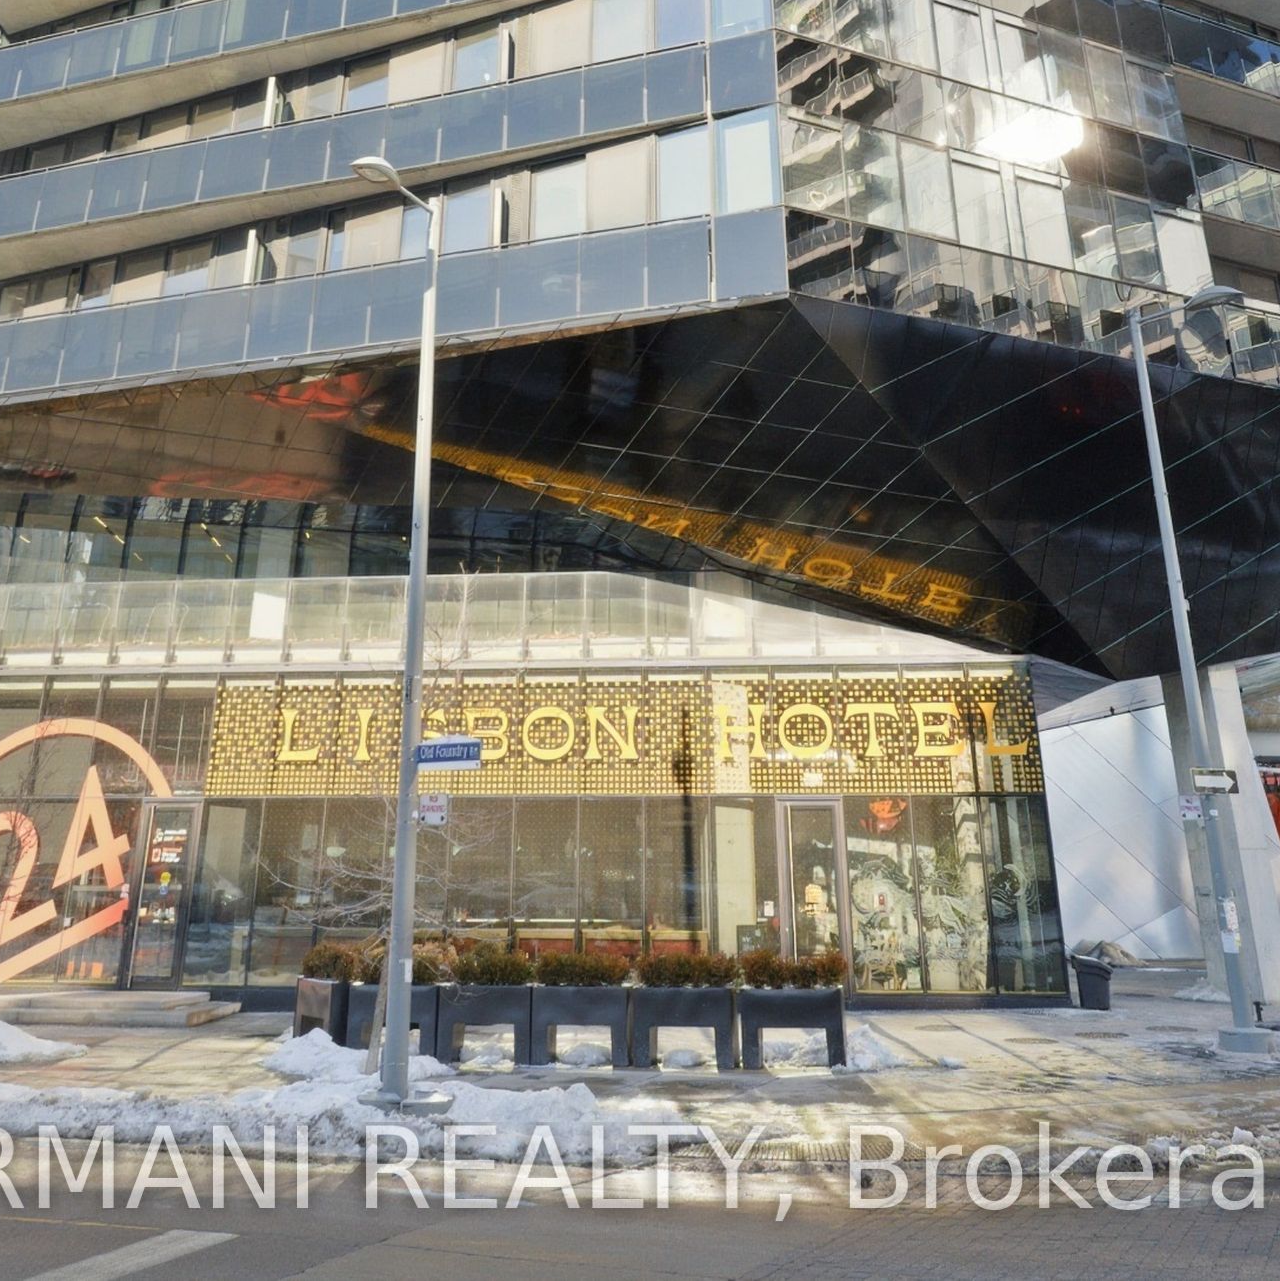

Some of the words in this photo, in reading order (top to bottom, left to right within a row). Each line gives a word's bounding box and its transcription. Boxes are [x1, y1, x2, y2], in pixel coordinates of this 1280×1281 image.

[720, 702, 1030, 758] HOTEL
[420, 746, 435, 759] Old
[435, 745, 468, 759] Foundry
